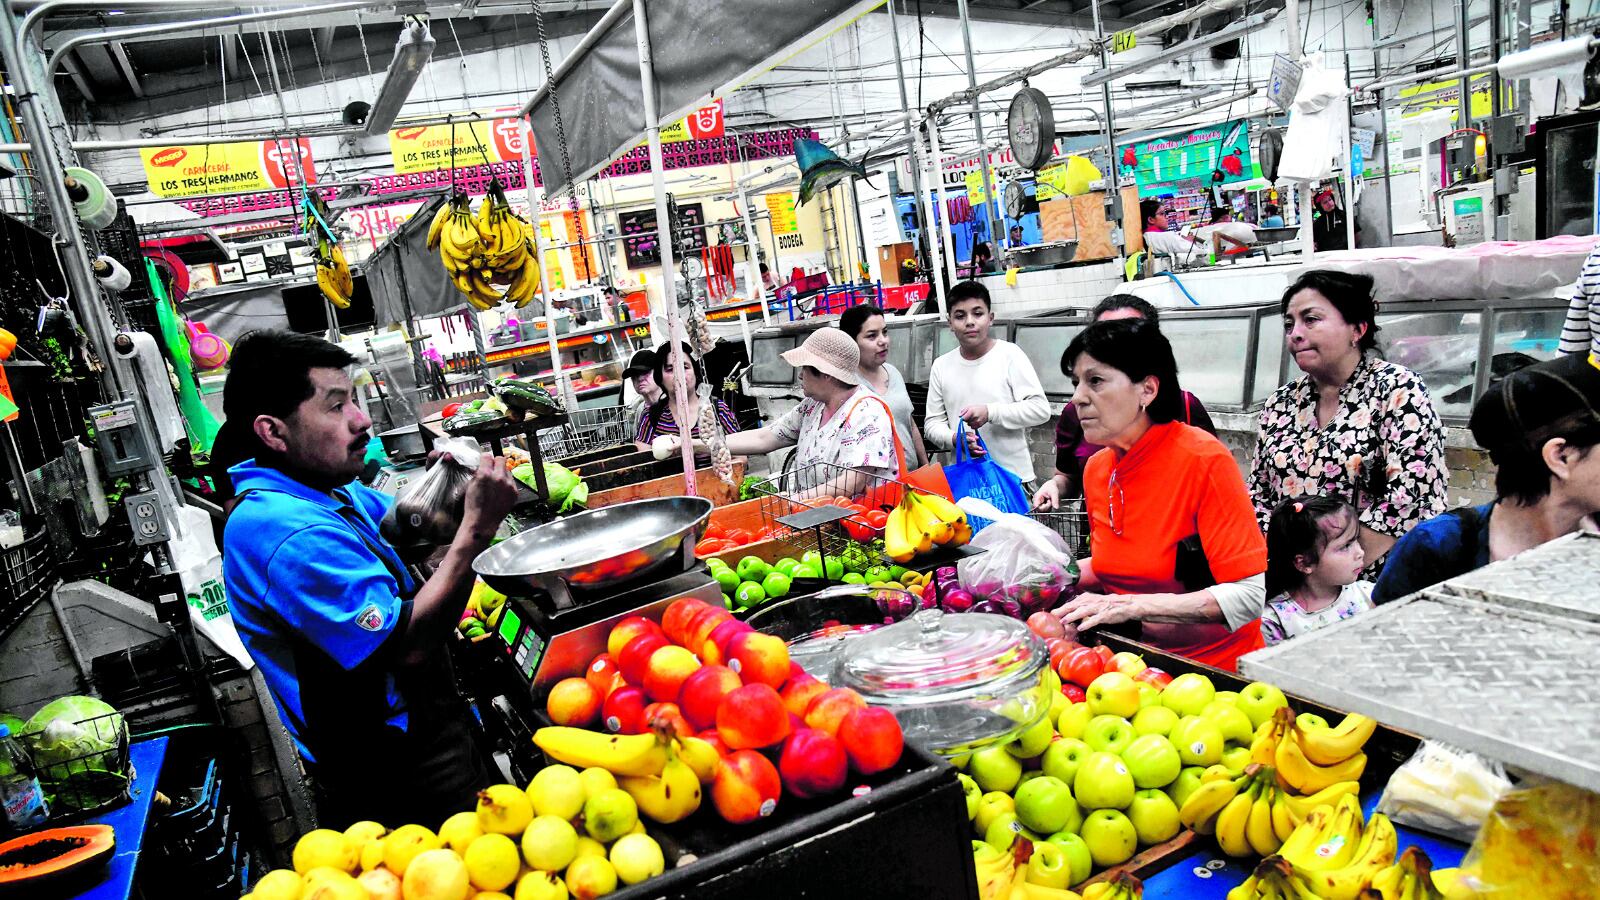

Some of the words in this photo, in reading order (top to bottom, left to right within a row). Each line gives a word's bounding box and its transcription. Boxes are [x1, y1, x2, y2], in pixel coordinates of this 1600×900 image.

[403, 153, 418, 162] LOS
[421, 149, 441, 160] TRES
[444, 144, 488, 157] HERMANOS
[161, 180, 178, 190] LOS
[182, 177, 206, 188] TRES
[208, 171, 259, 185] HERMANOS
[778, 233, 804, 250] BODEGA
[904, 290, 919, 304] 145
